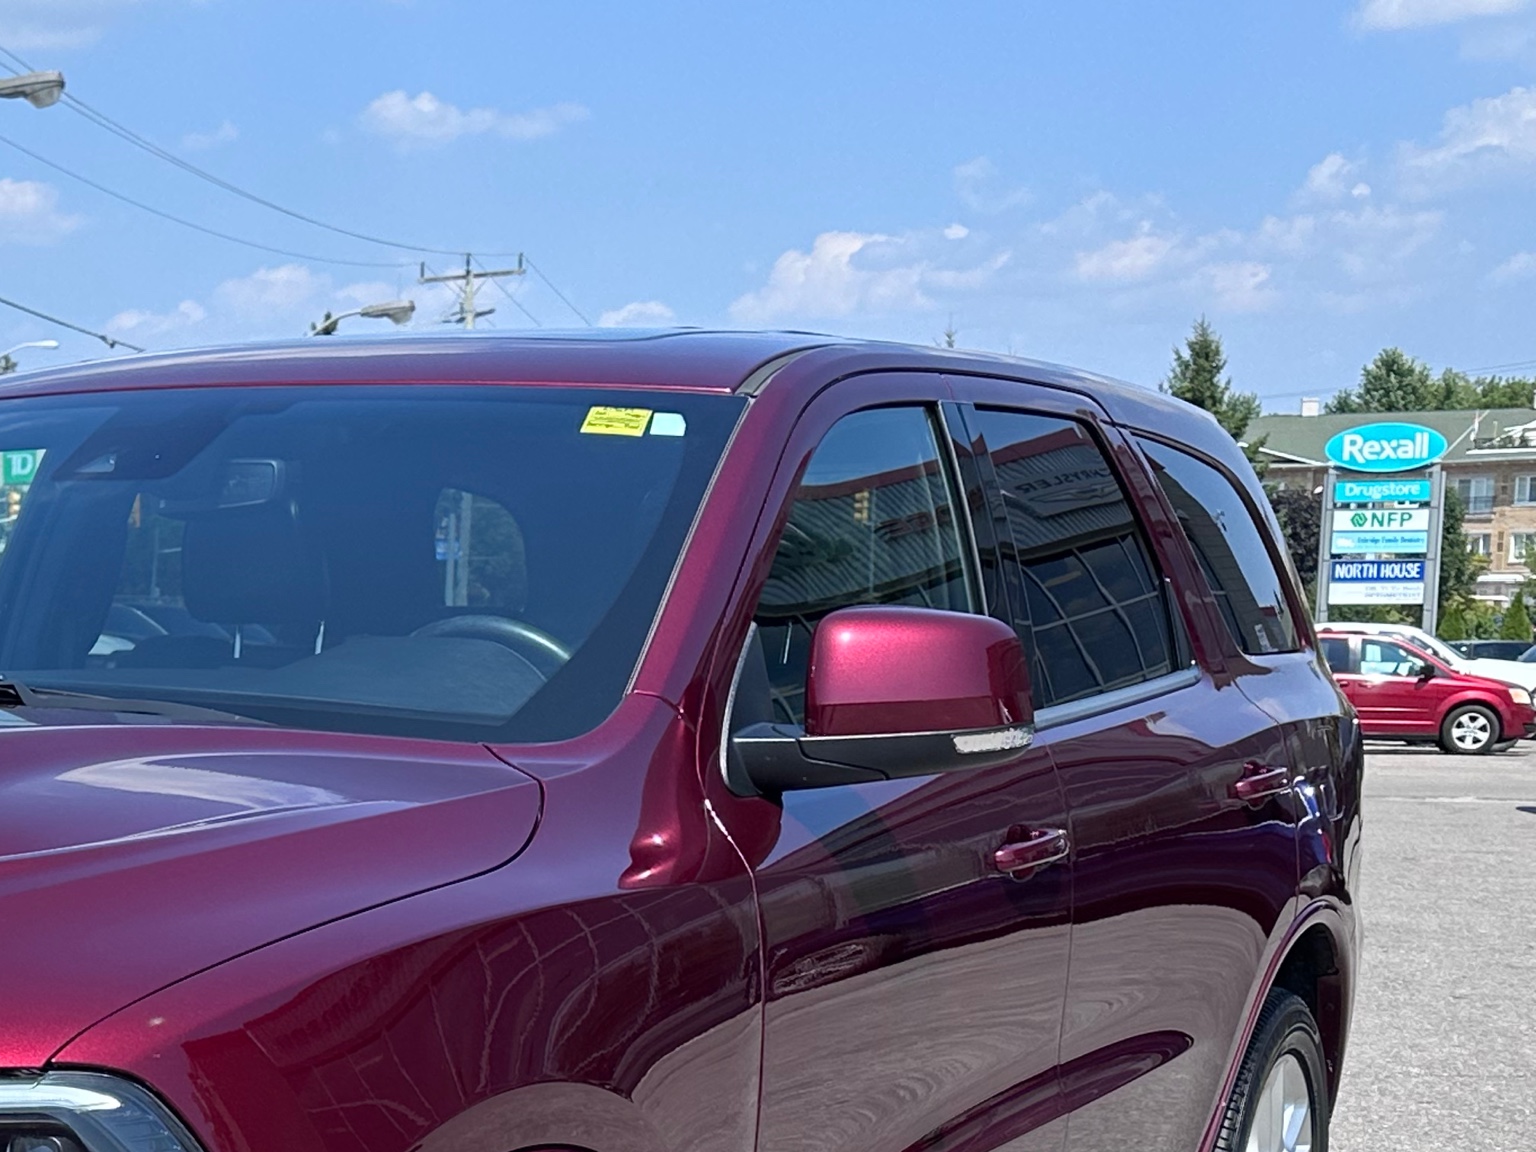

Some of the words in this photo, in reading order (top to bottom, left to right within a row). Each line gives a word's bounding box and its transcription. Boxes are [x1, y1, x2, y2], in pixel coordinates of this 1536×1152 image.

[1342, 431, 1429, 463] Rexall
[6, 453, 34, 477] TD
[1344, 482, 1421, 499] Drugstore
[1370, 511, 1413, 527] NFP
[1334, 563, 1378, 579] NORTH
[1379, 563, 1421, 579] HOUSE
